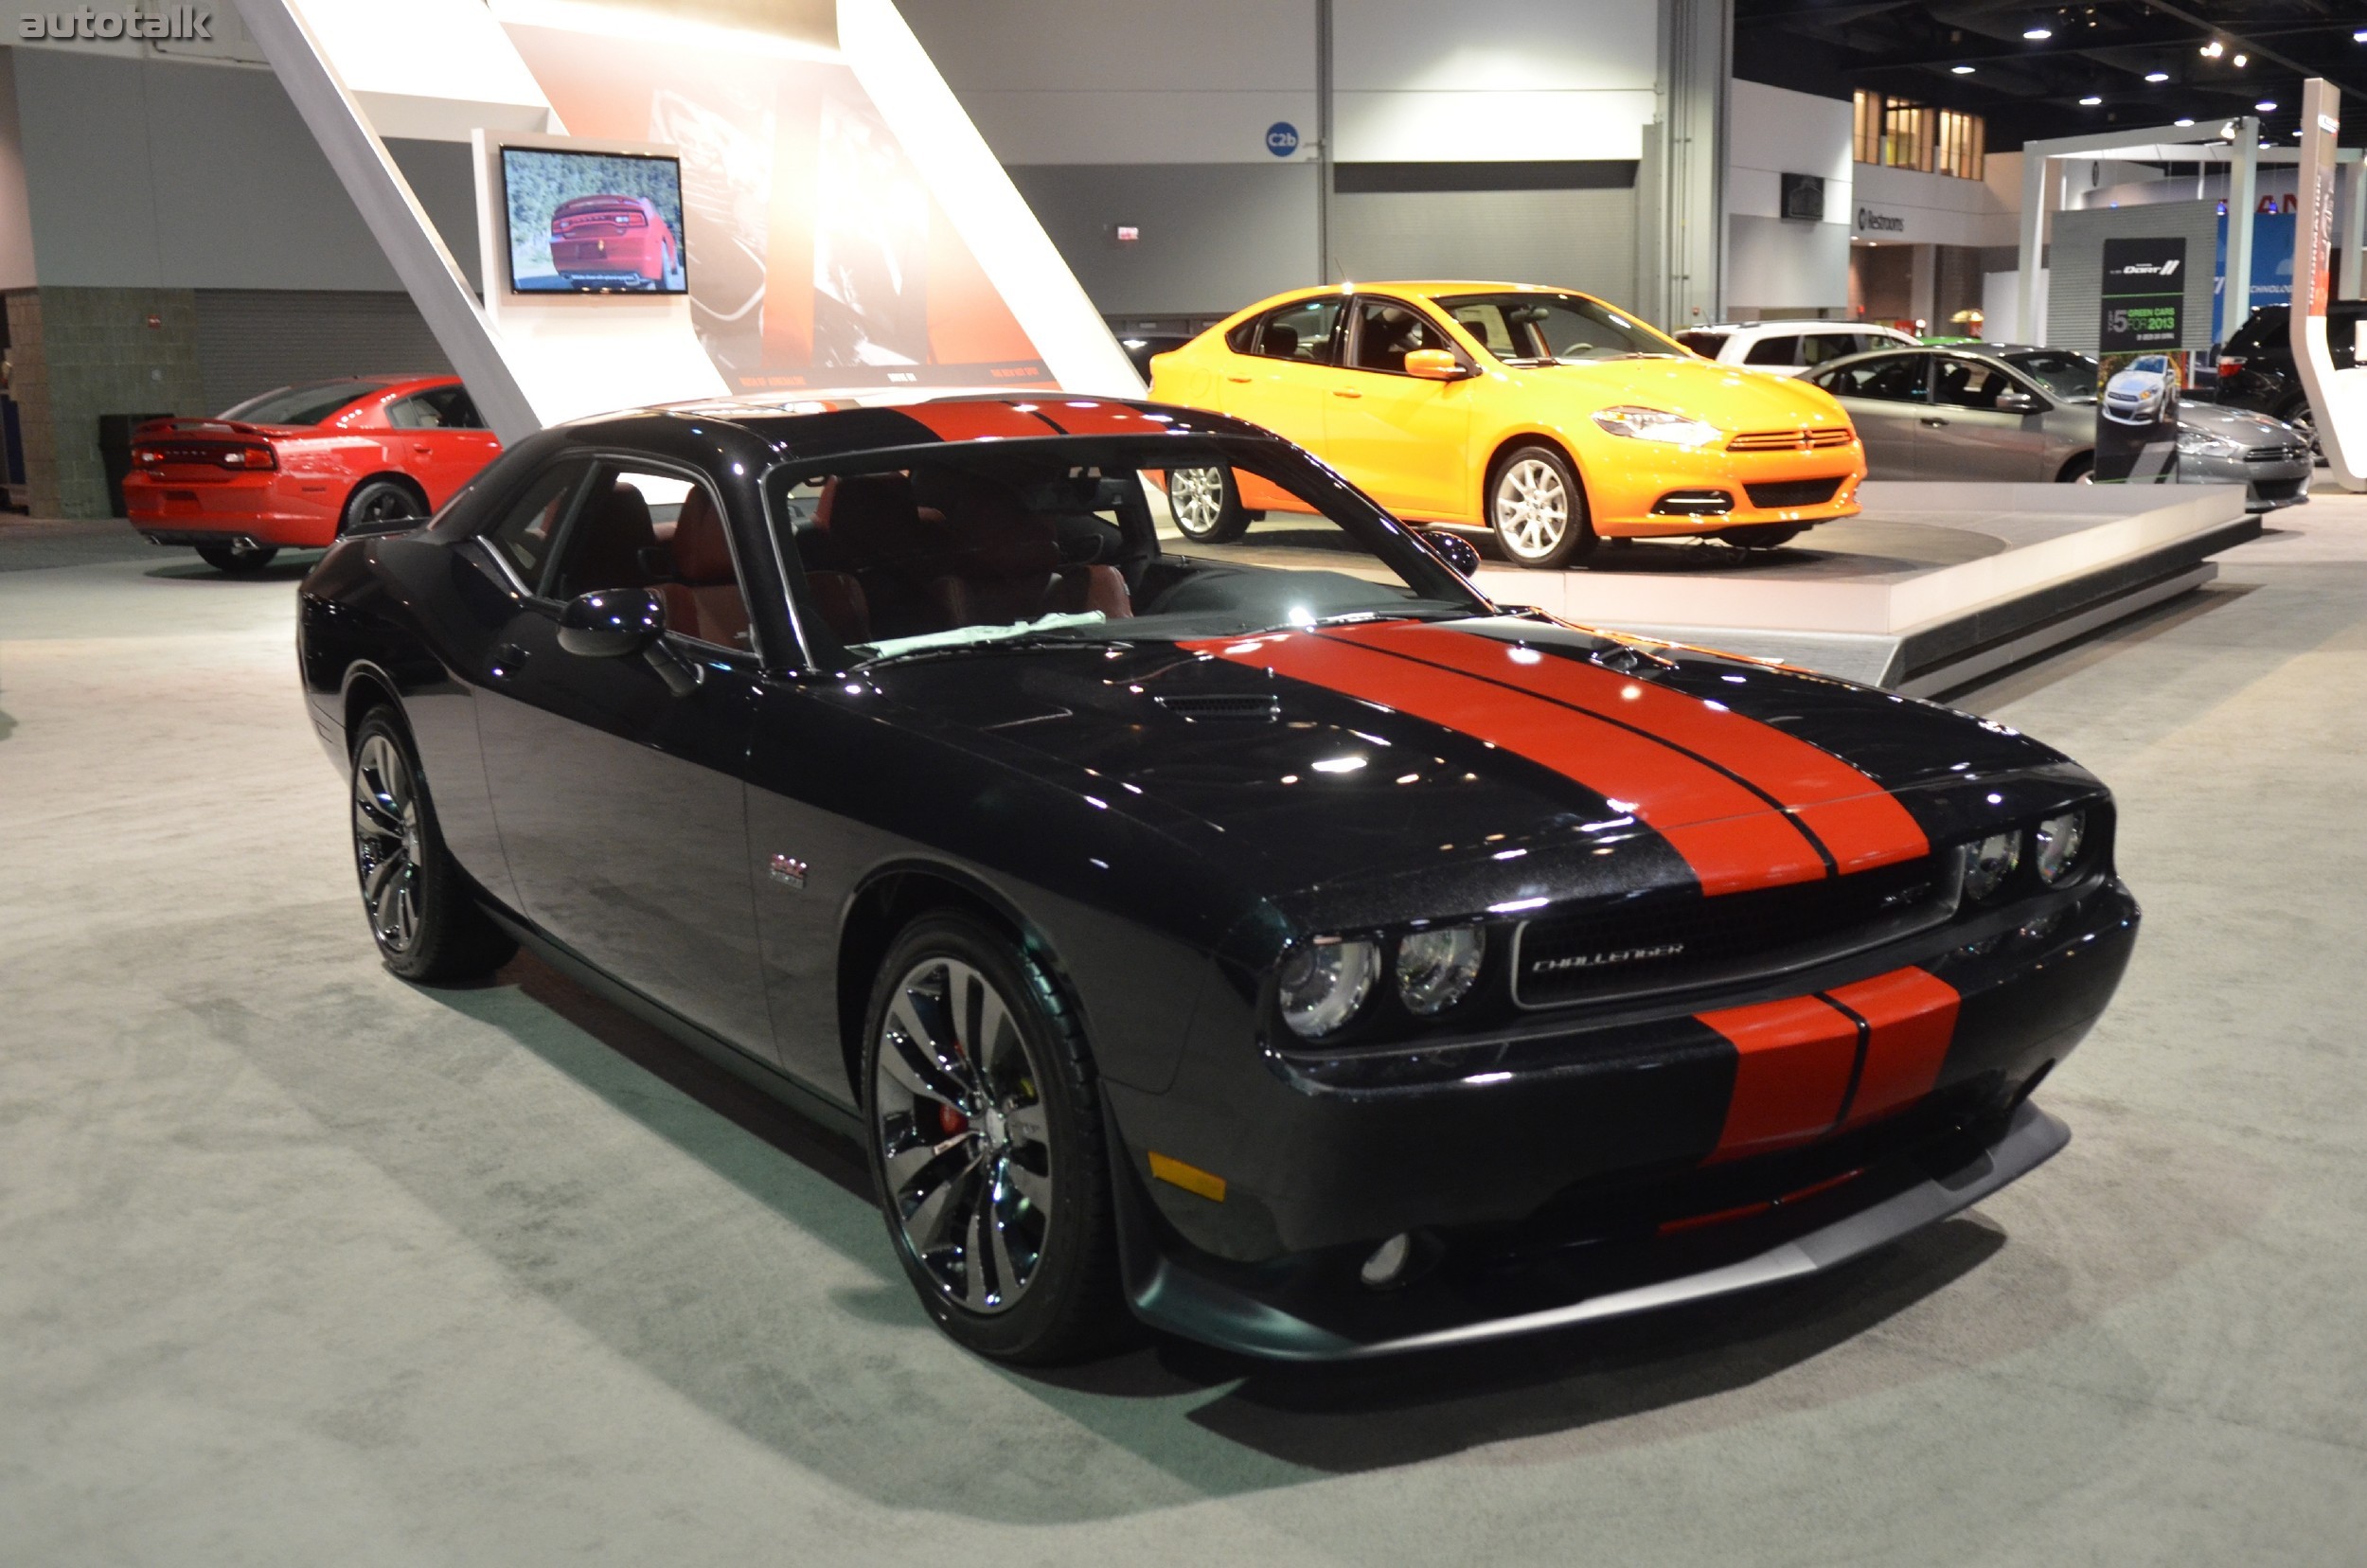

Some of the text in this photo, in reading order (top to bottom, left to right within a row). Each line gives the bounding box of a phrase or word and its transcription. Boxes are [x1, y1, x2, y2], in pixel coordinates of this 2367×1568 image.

[1269, 133, 1297, 147] C2b
[1868, 209, 1905, 232] Restrooms
[2112, 309, 2127, 333] 5
[2154, 307, 2176, 317] CARS
[2147, 316, 2175, 330] 2013
[1532, 943, 1684, 972] CHALLENGER
